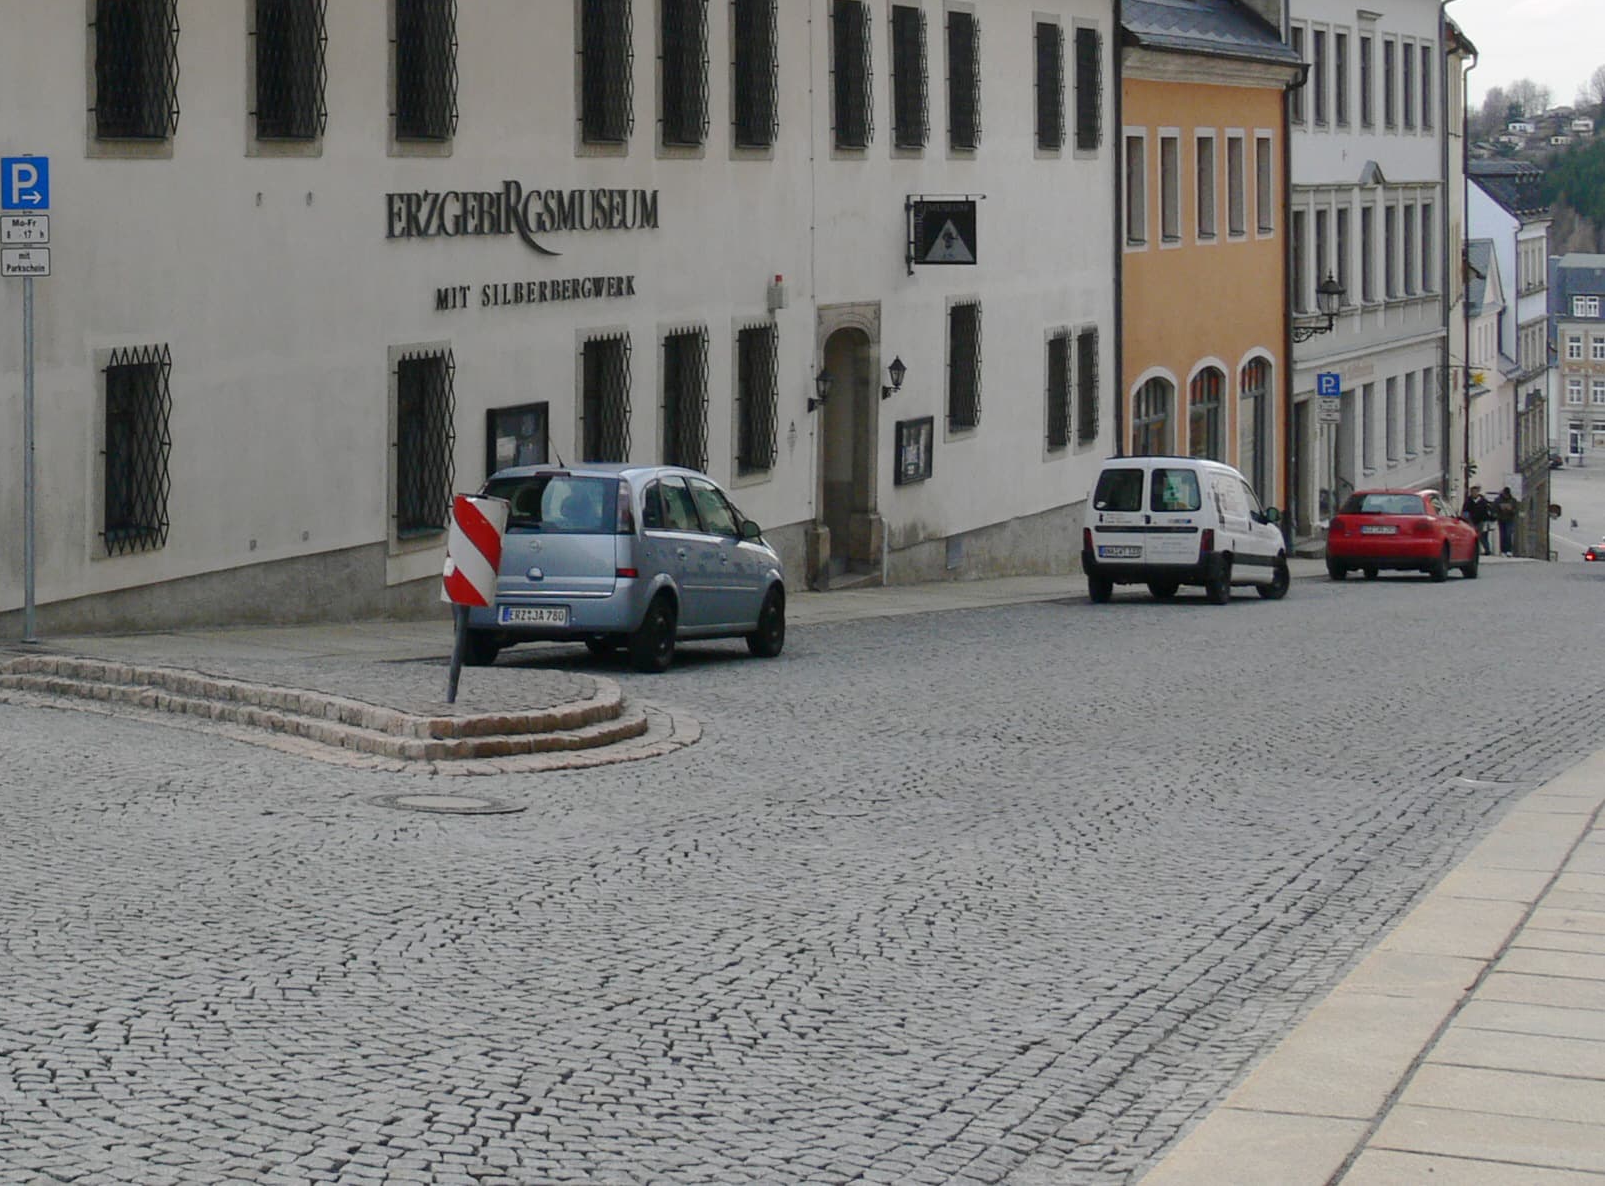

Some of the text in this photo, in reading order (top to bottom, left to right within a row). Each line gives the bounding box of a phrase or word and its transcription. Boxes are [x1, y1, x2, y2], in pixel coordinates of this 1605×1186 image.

[12, 162, 38, 204] P
[11, 219, 37, 227] Mo-Fr
[23, 230, 33, 239] 17
[385, 180, 660, 256] ERZGEBIRGSMUSEUM
[435, 275, 636, 311] MIT SILBERBERGWERK
